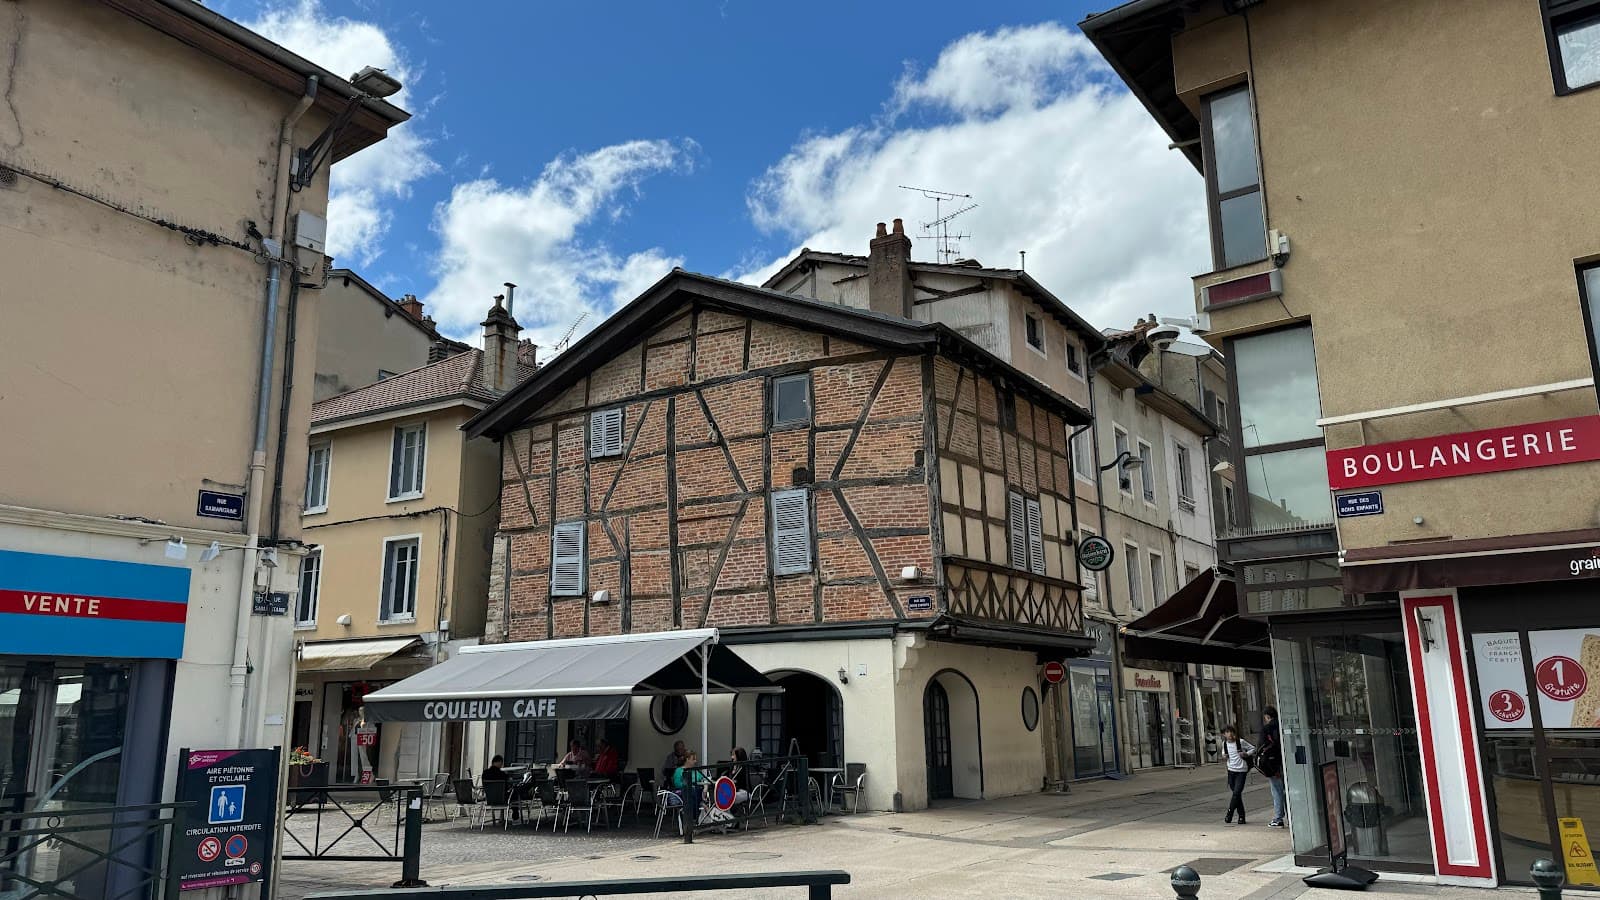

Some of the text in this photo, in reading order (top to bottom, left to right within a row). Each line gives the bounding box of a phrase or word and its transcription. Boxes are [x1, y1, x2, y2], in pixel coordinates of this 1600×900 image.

[1343, 428, 1577, 478] BOULANGERIE
[1356, 503, 1379, 511] ENFANTS
[23, 595, 100, 615] VENTE
[1551, 660, 1564, 686] 1
[1544, 683, 1580, 696] Gratuite
[423, 698, 557, 719] COULEUR CAFE
[1501, 693, 1513, 712] 3
[206, 765, 255, 775] AIRE PIÉTONNE
[218, 774, 251, 782] CYCLABLE
[186, 823, 262, 836] CIRCULATION INTERDITE
